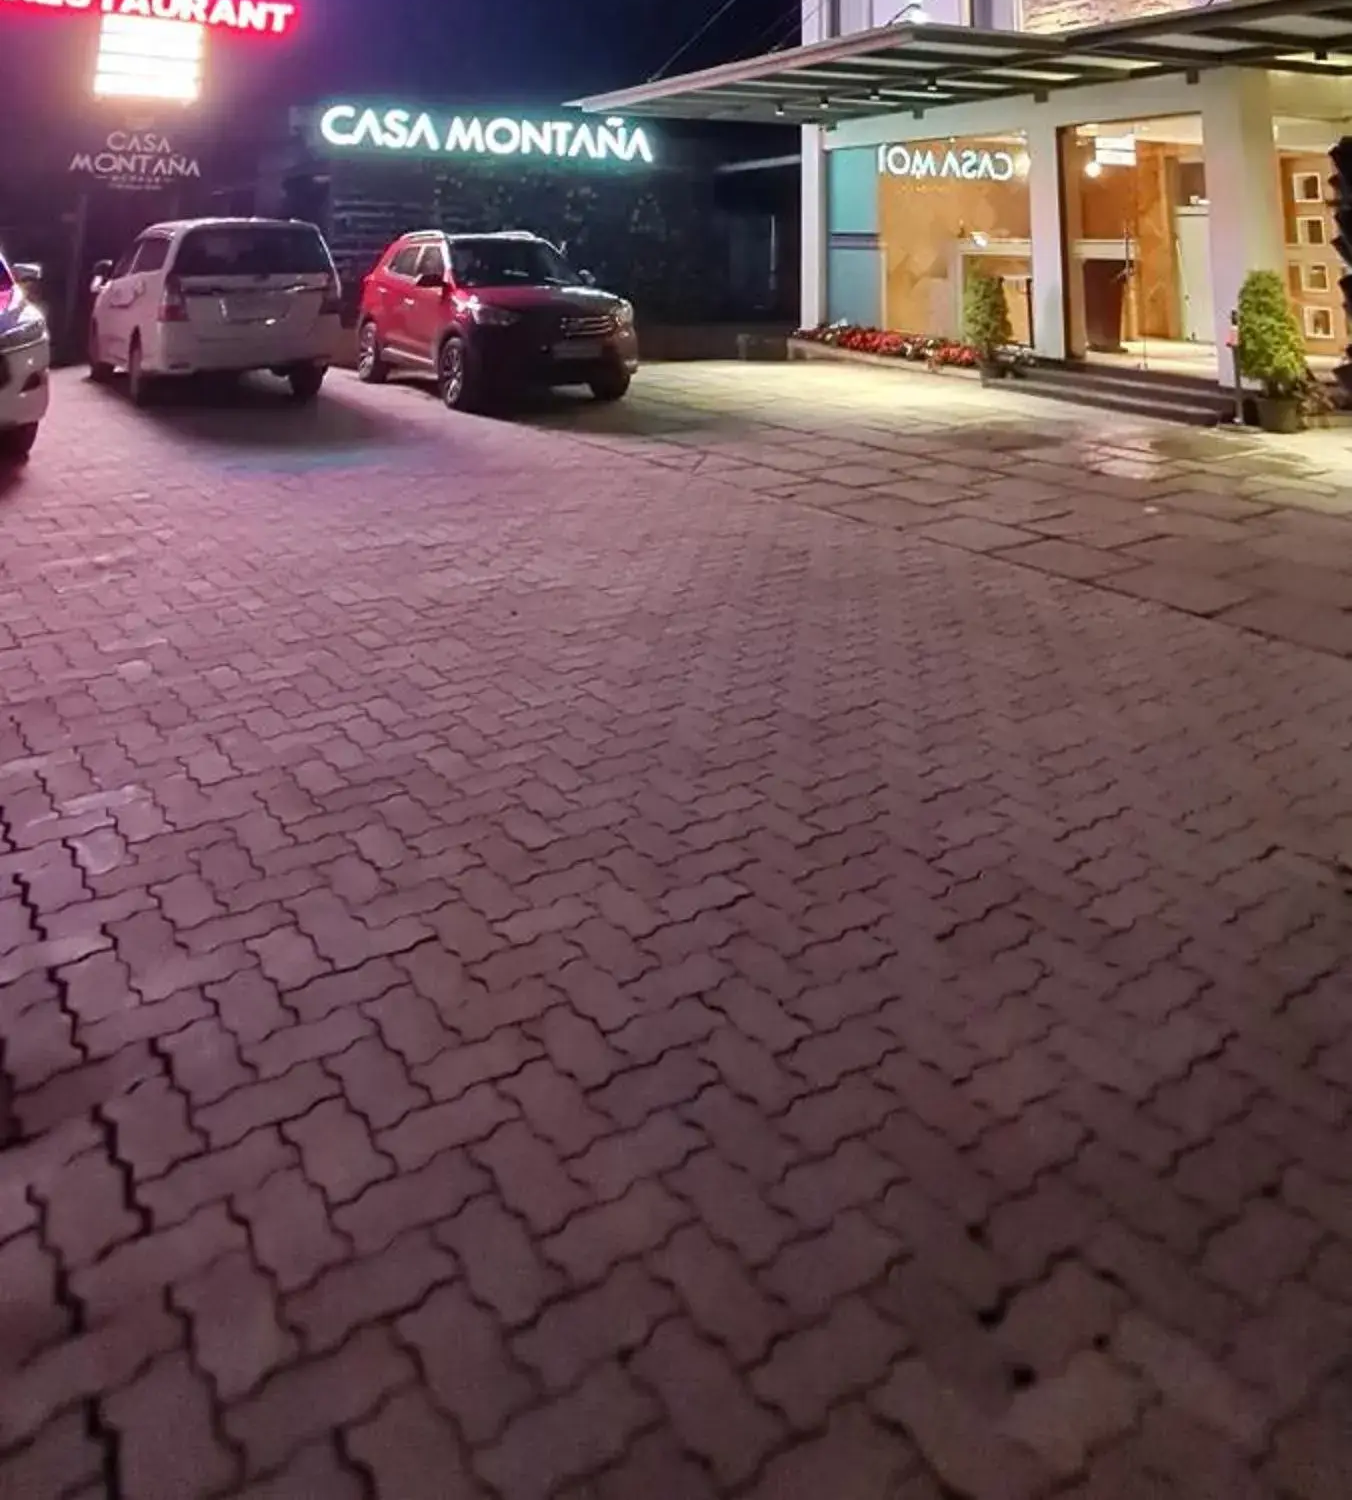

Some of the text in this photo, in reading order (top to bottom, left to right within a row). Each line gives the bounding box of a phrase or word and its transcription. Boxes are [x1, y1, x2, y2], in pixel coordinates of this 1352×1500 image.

[106, 131, 171, 153] CASA
[321, 105, 653, 163] CASA MONTAÑA
[69, 153, 200, 177] MONTAÑA
